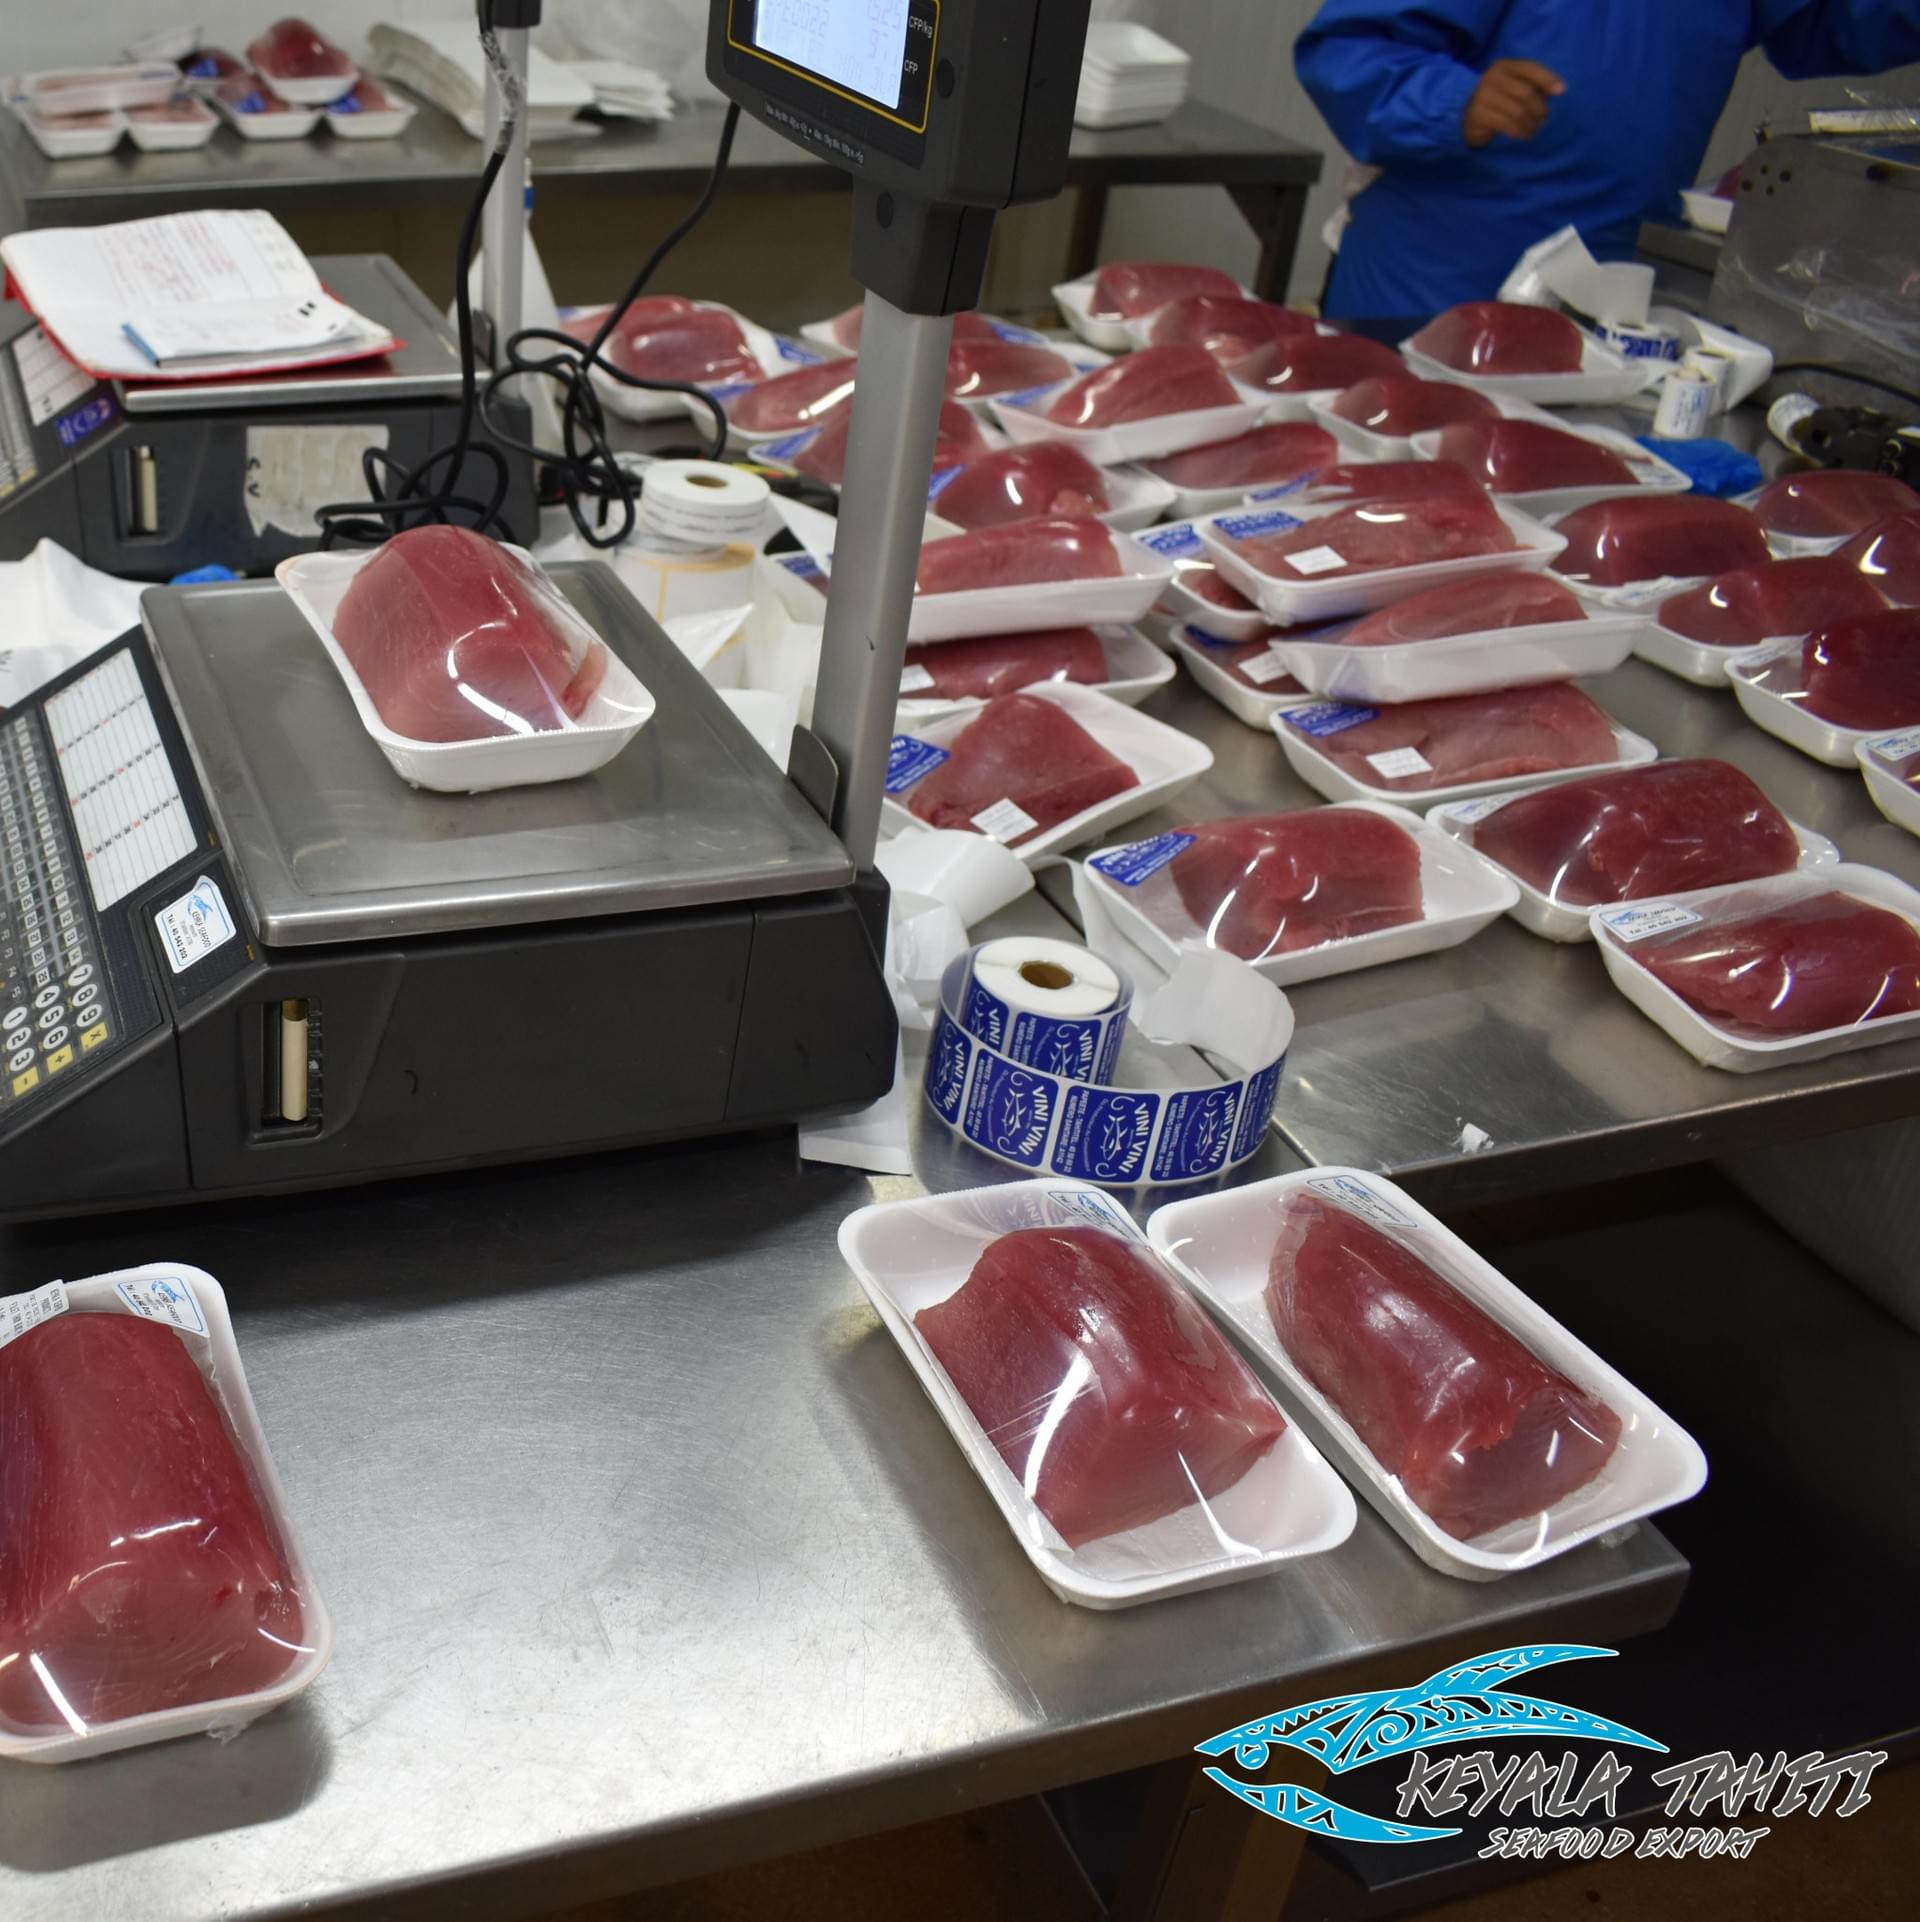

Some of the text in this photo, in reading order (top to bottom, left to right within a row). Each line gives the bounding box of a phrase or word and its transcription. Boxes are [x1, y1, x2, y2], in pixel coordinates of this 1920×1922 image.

[904, 60, 918, 75] CFP
[73, 967, 89, 979] 7
[41, 992, 56, 1003] 4
[78, 988, 93, 1002] 8
[45, 1010, 60, 1023] 5
[82, 1008, 98, 1022] 9
[988, 1008, 1000, 1045] VINI
[11, 1031, 26, 1046] 2
[49, 1030, 64, 1044] 6
[1079, 1028, 1093, 1062] VINI
[15, 1052, 30, 1066] 3
[943, 1042, 965, 1112] VINI VINI
[1018, 1085, 1049, 1156] VINI VINI
[1209, 1092, 1235, 1163] VINI VINI
[1118, 1102, 1150, 1173] VINI VINI
